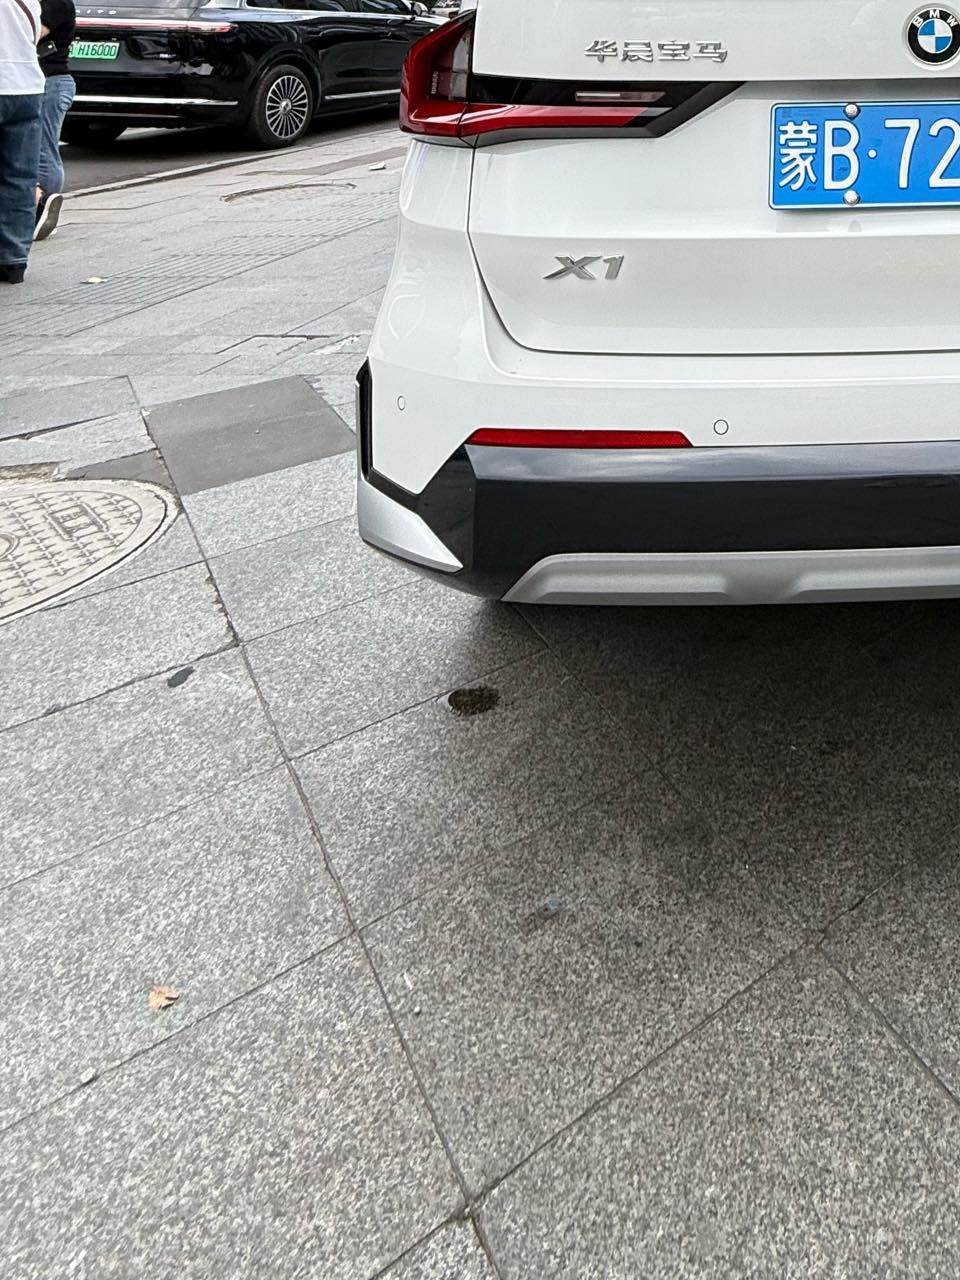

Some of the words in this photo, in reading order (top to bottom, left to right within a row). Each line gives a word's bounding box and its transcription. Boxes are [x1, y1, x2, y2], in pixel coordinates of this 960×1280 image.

[912, 9, 959, 28] BMW
[584, 39, 728, 63] 华晨宝马
[542, 255, 624, 281] X1
